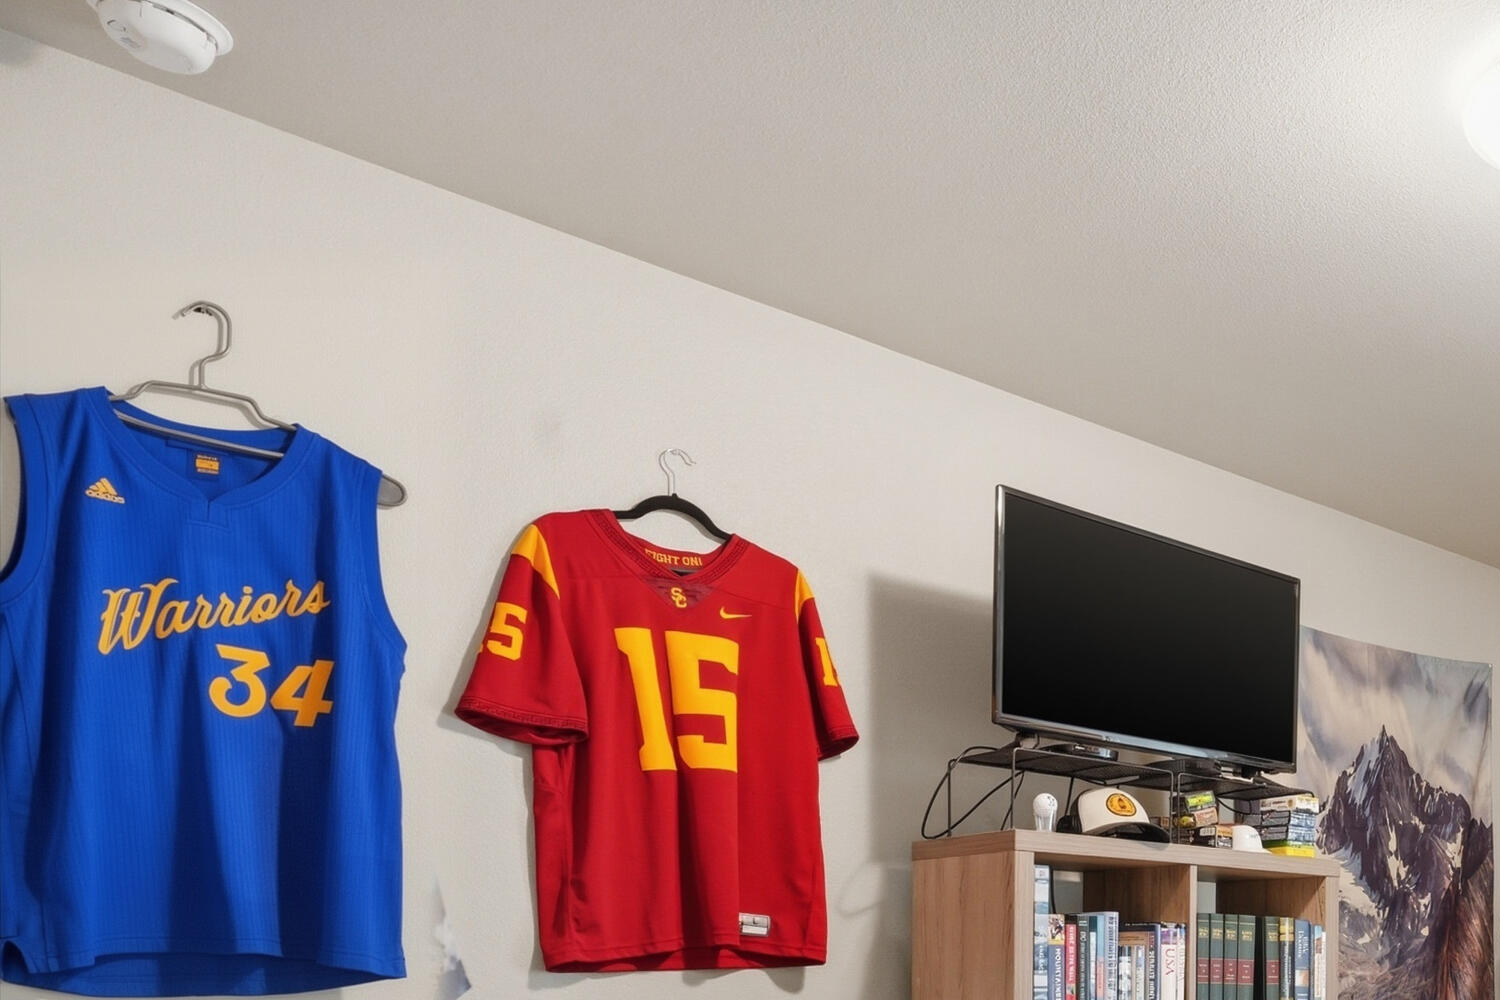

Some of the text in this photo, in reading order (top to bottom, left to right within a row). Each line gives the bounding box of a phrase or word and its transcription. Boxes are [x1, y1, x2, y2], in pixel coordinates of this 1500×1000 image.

[98, 578, 331, 655] Warriors
[478, 602, 527, 661] 5
[209, 643, 334, 727] 34
[815, 637, 838, 687] 1
[614, 627, 739, 773] 15
[1165, 948, 1175, 976] USA
